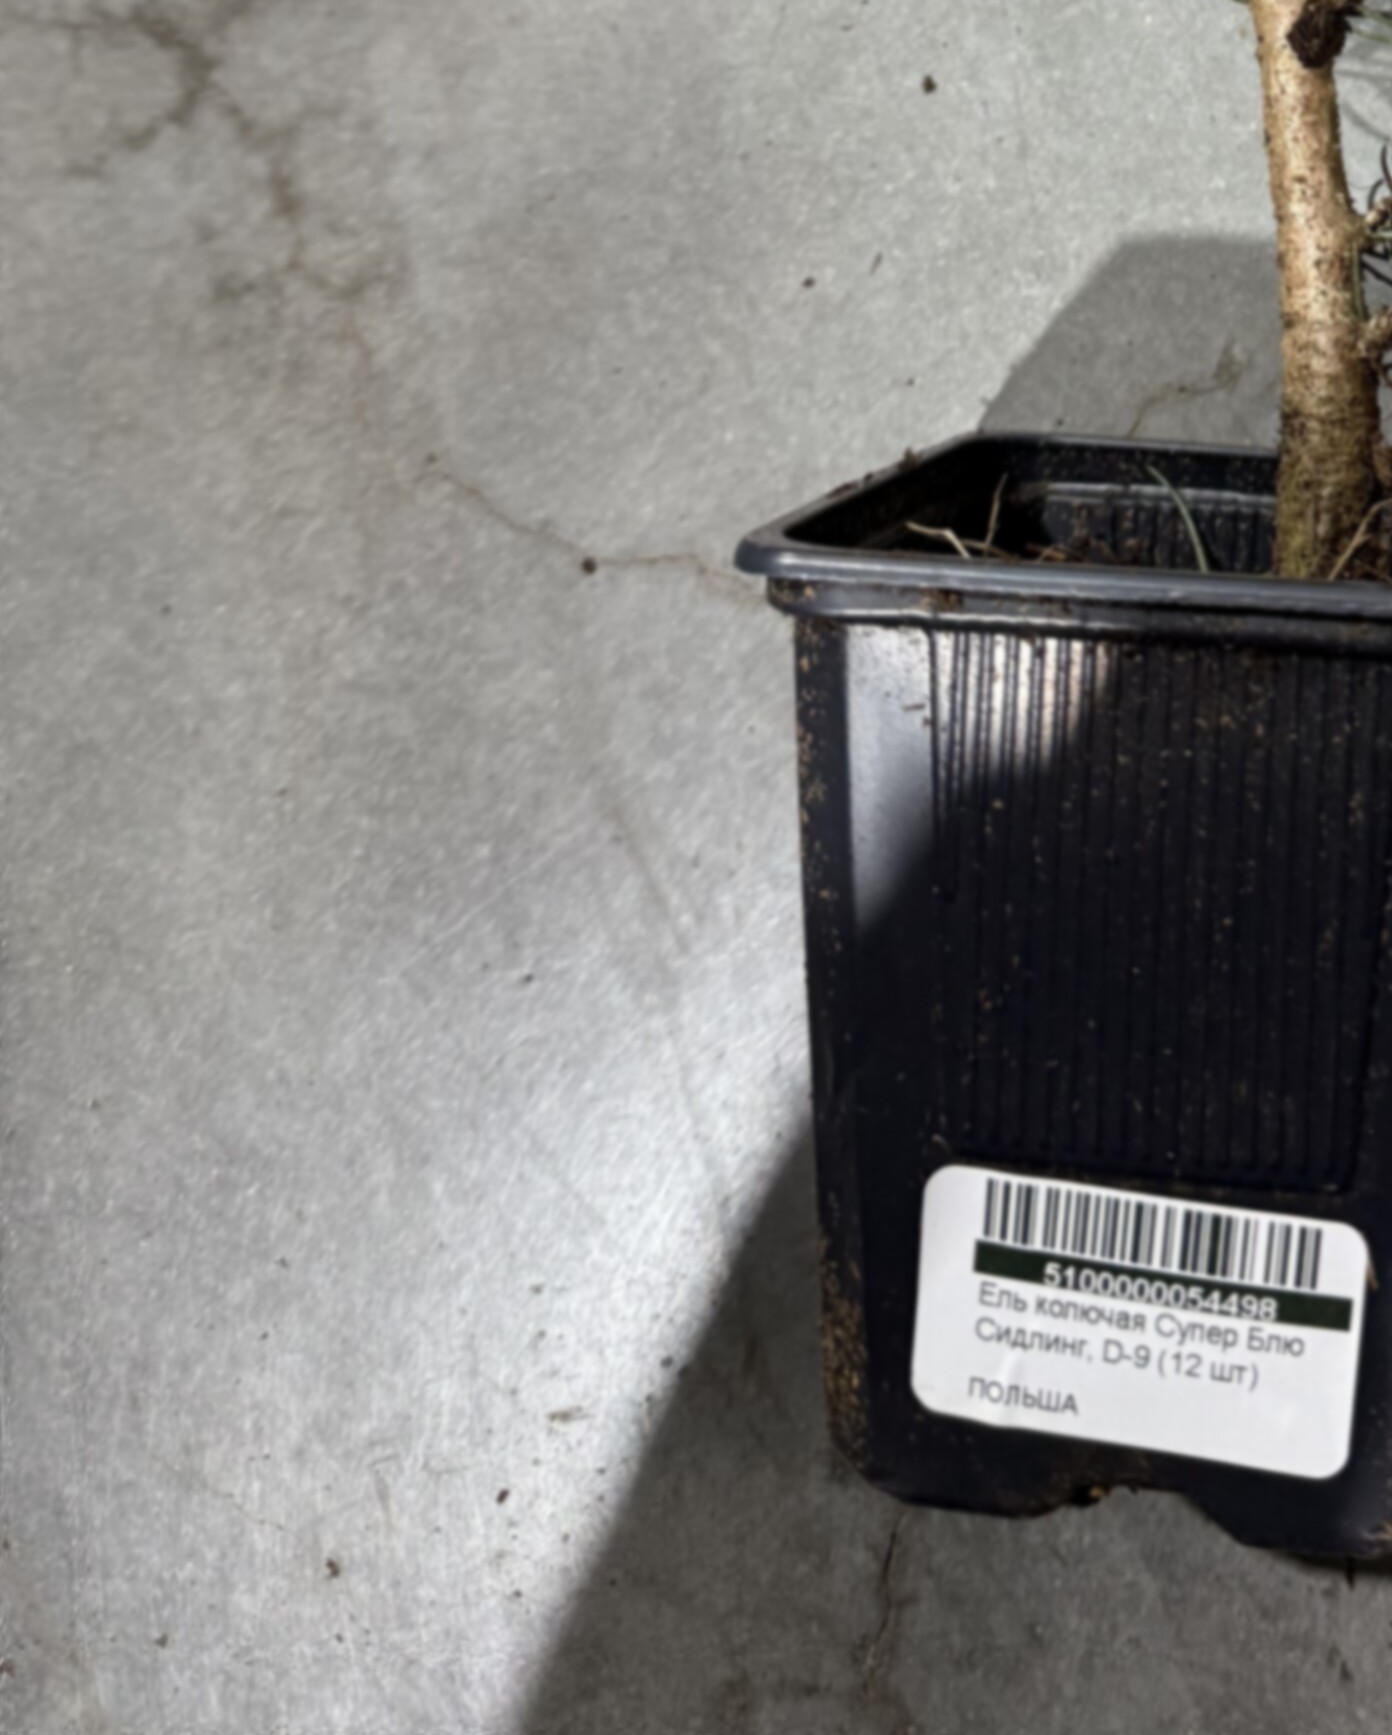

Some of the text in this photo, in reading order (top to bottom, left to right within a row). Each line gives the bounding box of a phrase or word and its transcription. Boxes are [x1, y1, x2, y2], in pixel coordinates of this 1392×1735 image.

[979, 1280, 1305, 1357] Ель колючая Супер Блю
[1043, 1262, 1278, 1321] 5100000054498
[975, 1317, 1260, 1392] Сидлинг, D-9 (12 шт)
[967, 1377, 1079, 1416] ПОЛЬША
